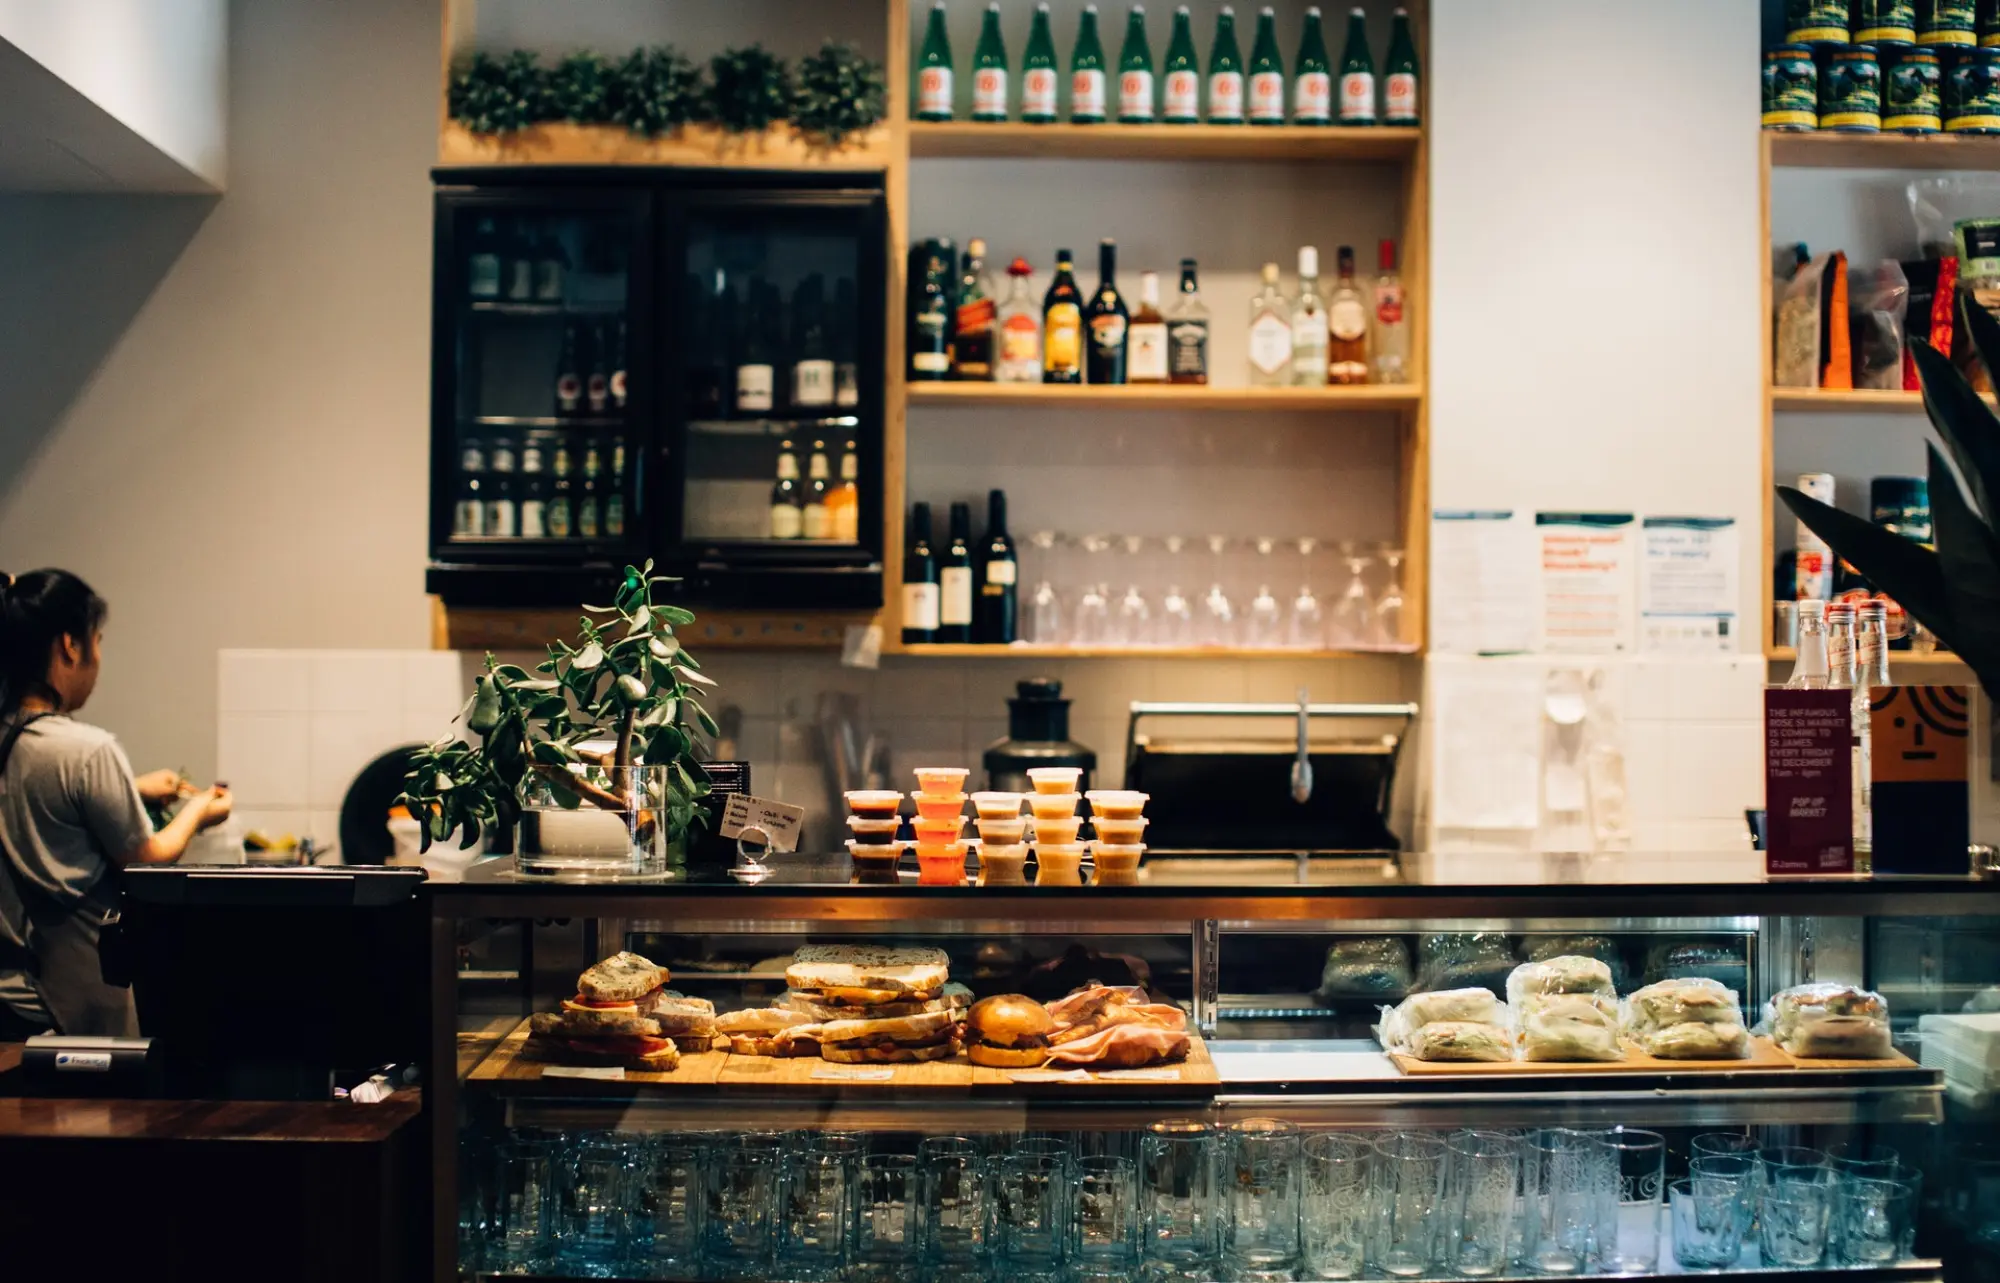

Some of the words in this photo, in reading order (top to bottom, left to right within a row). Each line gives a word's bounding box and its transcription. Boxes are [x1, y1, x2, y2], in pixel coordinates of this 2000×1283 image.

[1769, 708, 1787, 717] THE
[1807, 718, 1846, 727] MARKET
[1780, 728, 1818, 738] COMING
[1819, 728, 1832, 737] TO
[1781, 738, 1813, 747] JAMES
[1801, 748, 1835, 757] FRIDAY
[1782, 758, 1832, 767] DECEMBER
